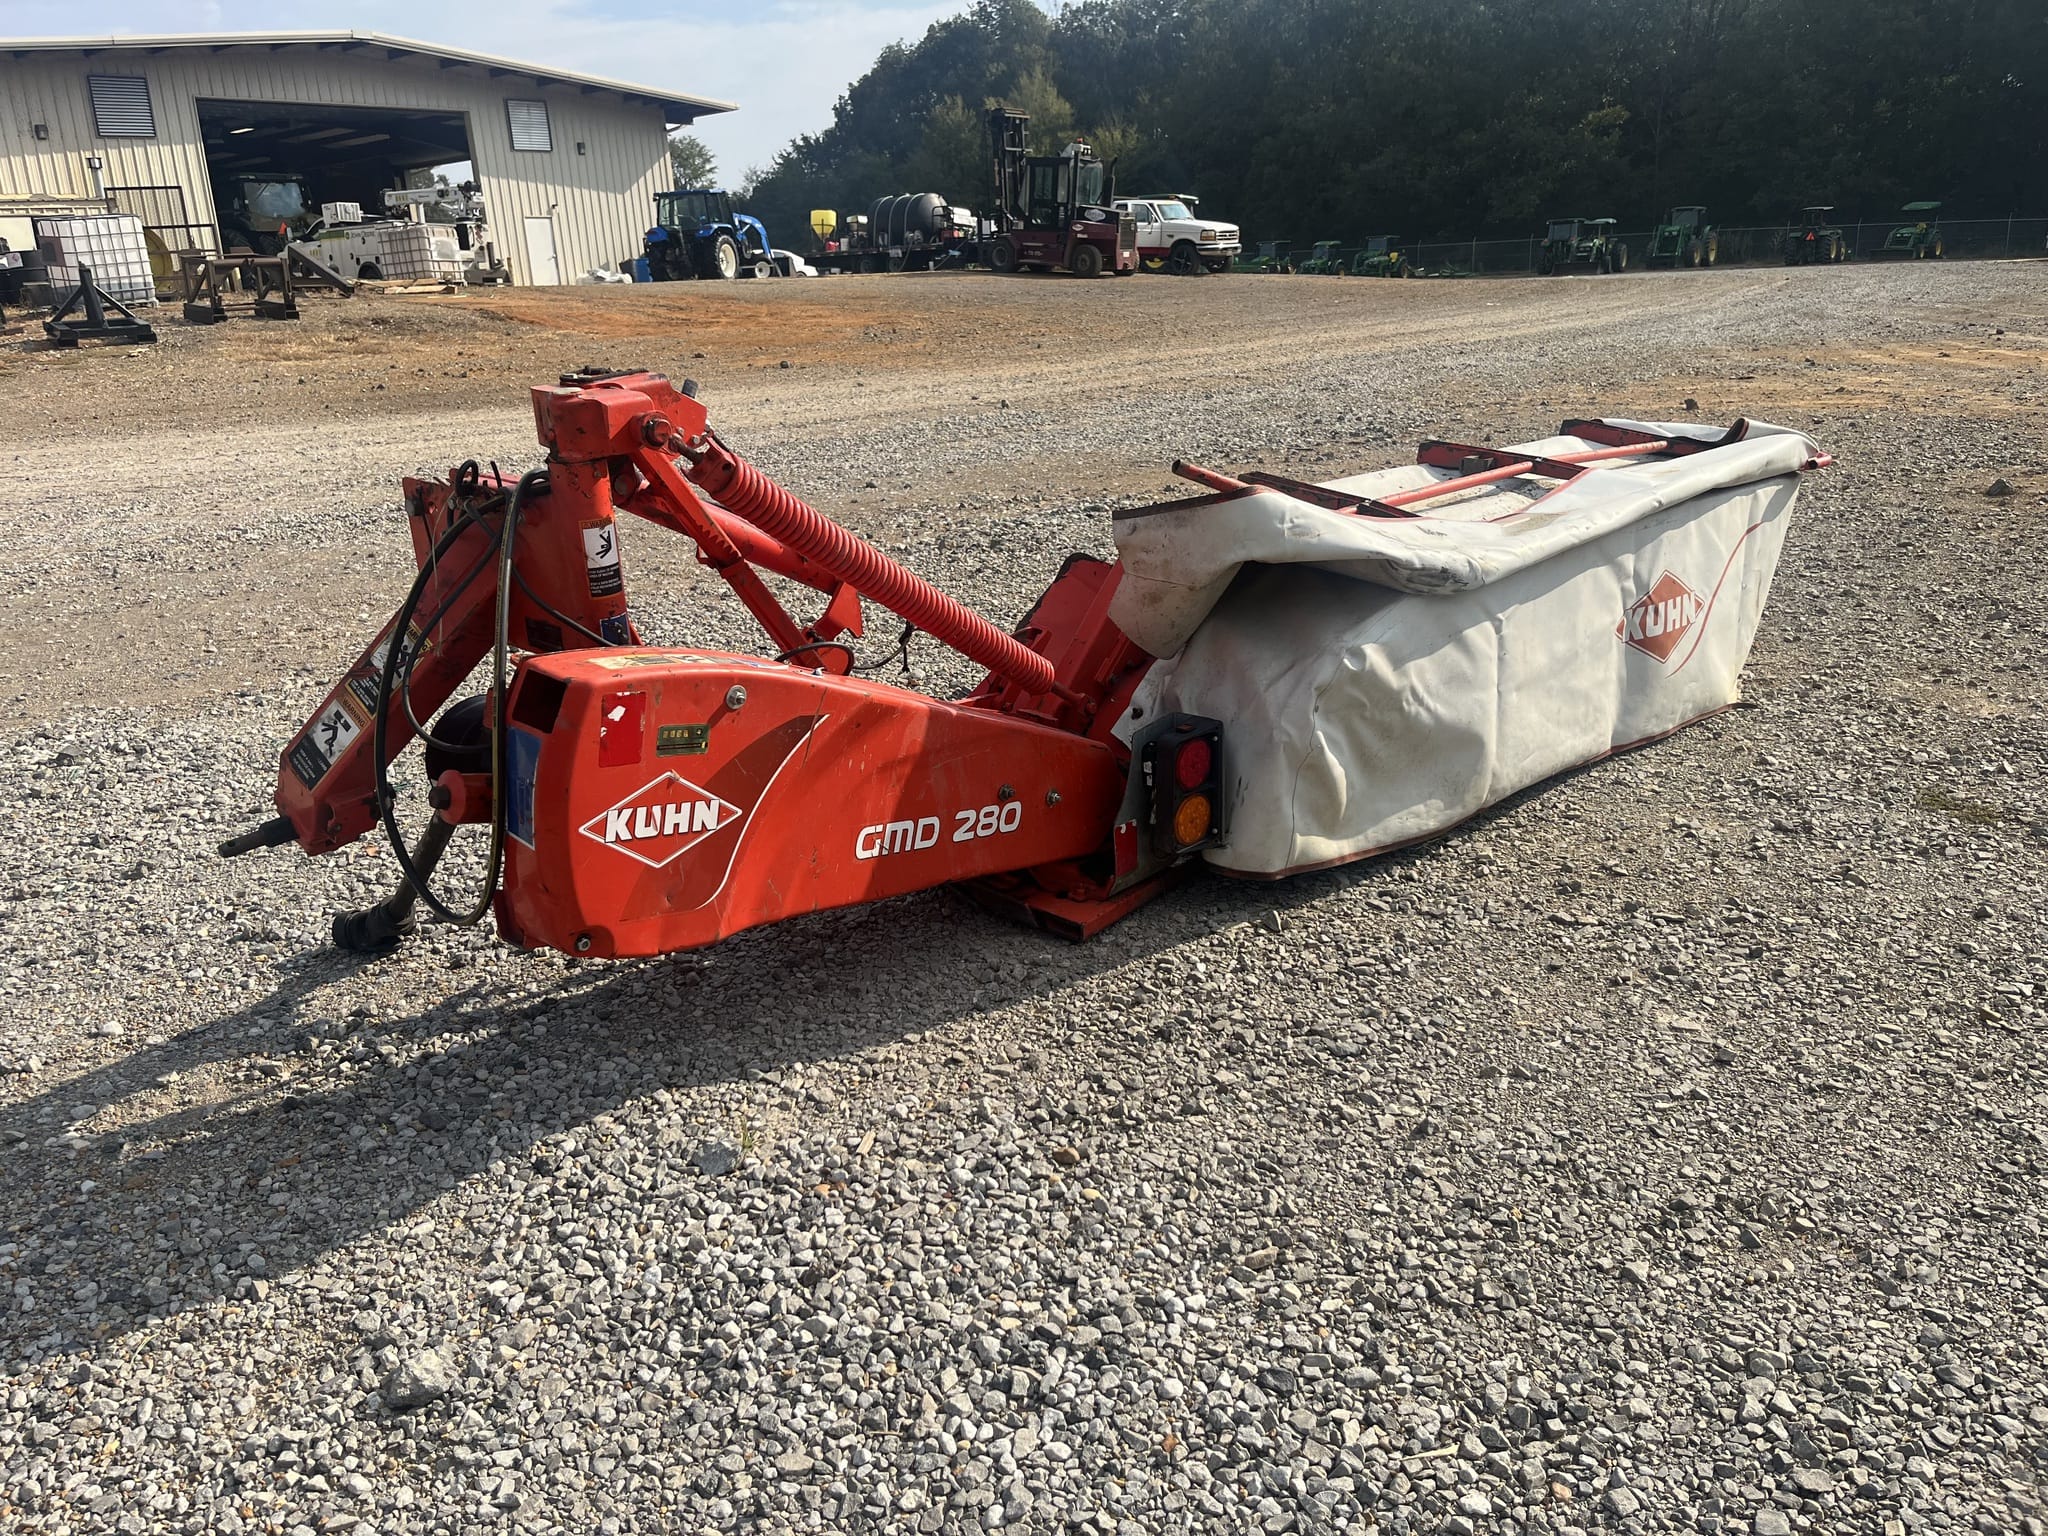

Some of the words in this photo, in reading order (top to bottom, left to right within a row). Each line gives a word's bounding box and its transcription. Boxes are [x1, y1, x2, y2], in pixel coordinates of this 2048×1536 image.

[1622, 590, 1696, 643] KUHN
[342, 698, 365, 729] WARNING
[604, 798, 720, 843] KUHN
[855, 815, 940, 860] GMD
[952, 800, 1022, 843] 280
